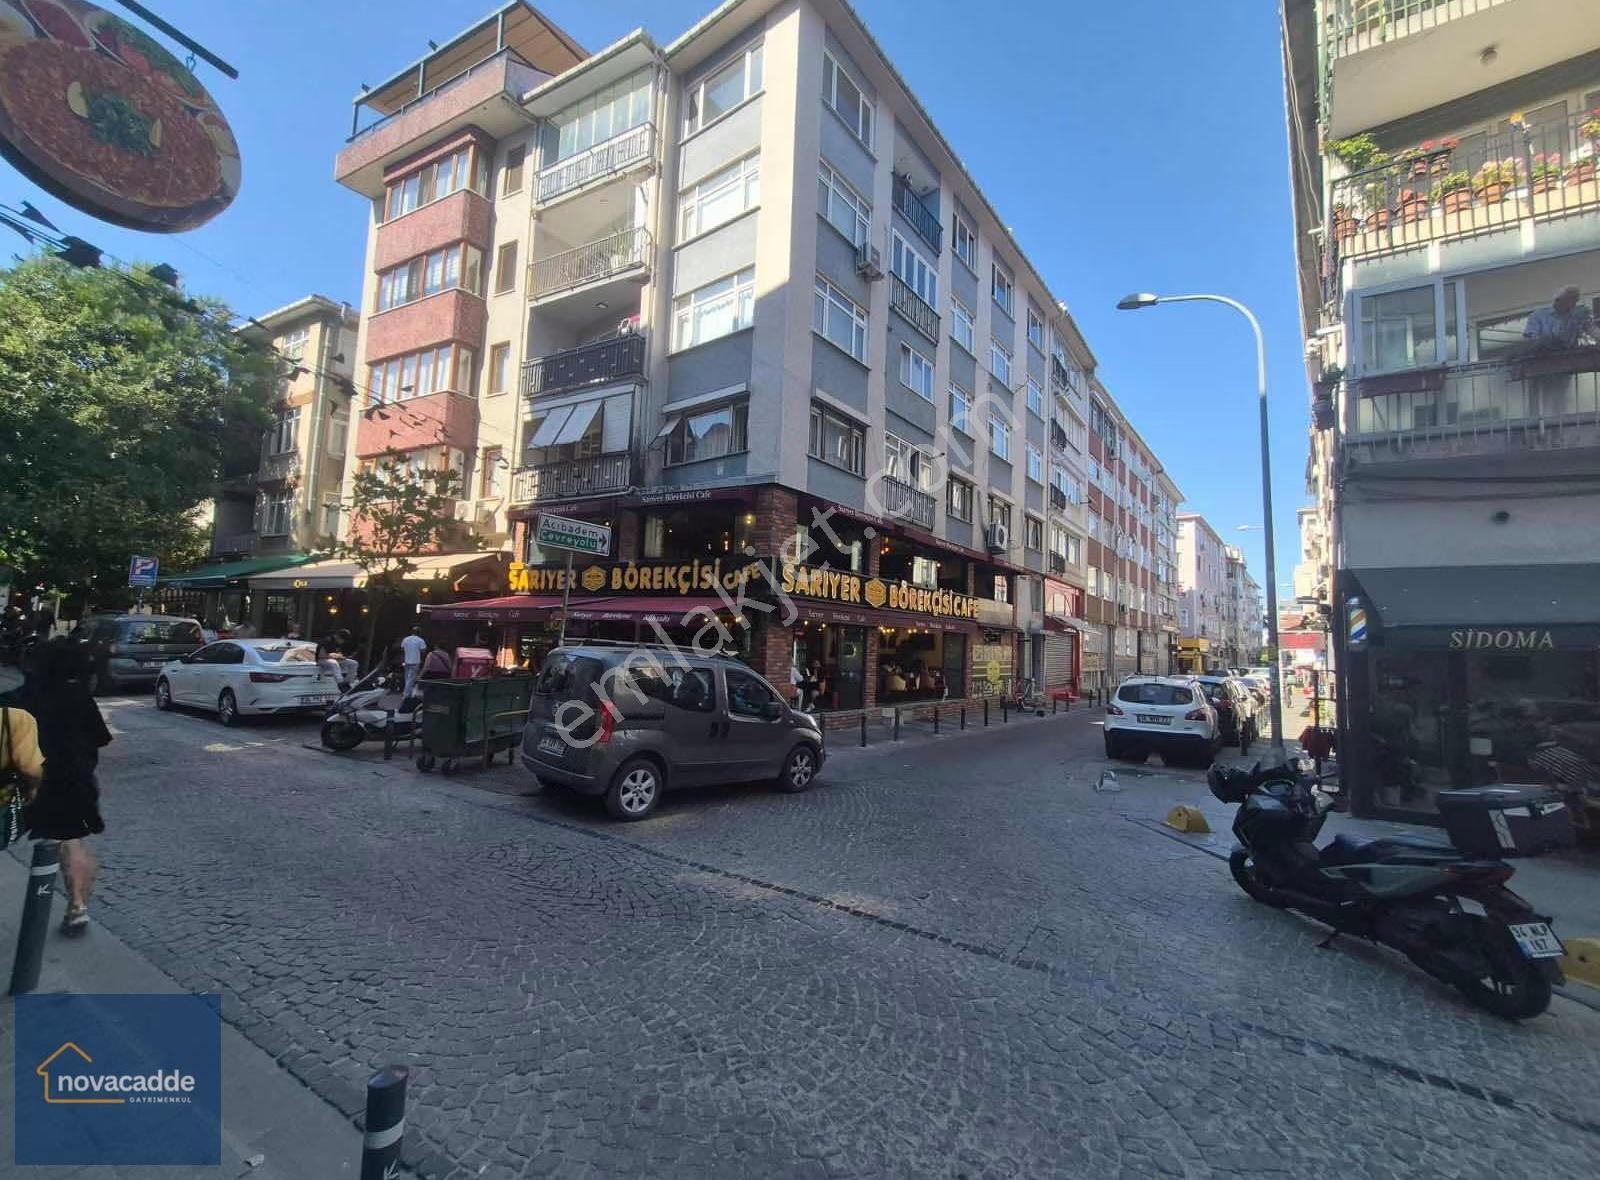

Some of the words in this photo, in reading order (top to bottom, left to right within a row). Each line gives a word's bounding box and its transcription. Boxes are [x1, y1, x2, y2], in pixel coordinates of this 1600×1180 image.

[610, 558, 721, 595] BÖREKÇİSİ
[722, 562, 761, 590] CAFE
[781, 564, 861, 602] SARIYER
[889, 579, 954, 617] BÖREKÇİSİ
[953, 597, 980, 619] CAFE
[1450, 628, 1554, 649] SİDOMA
